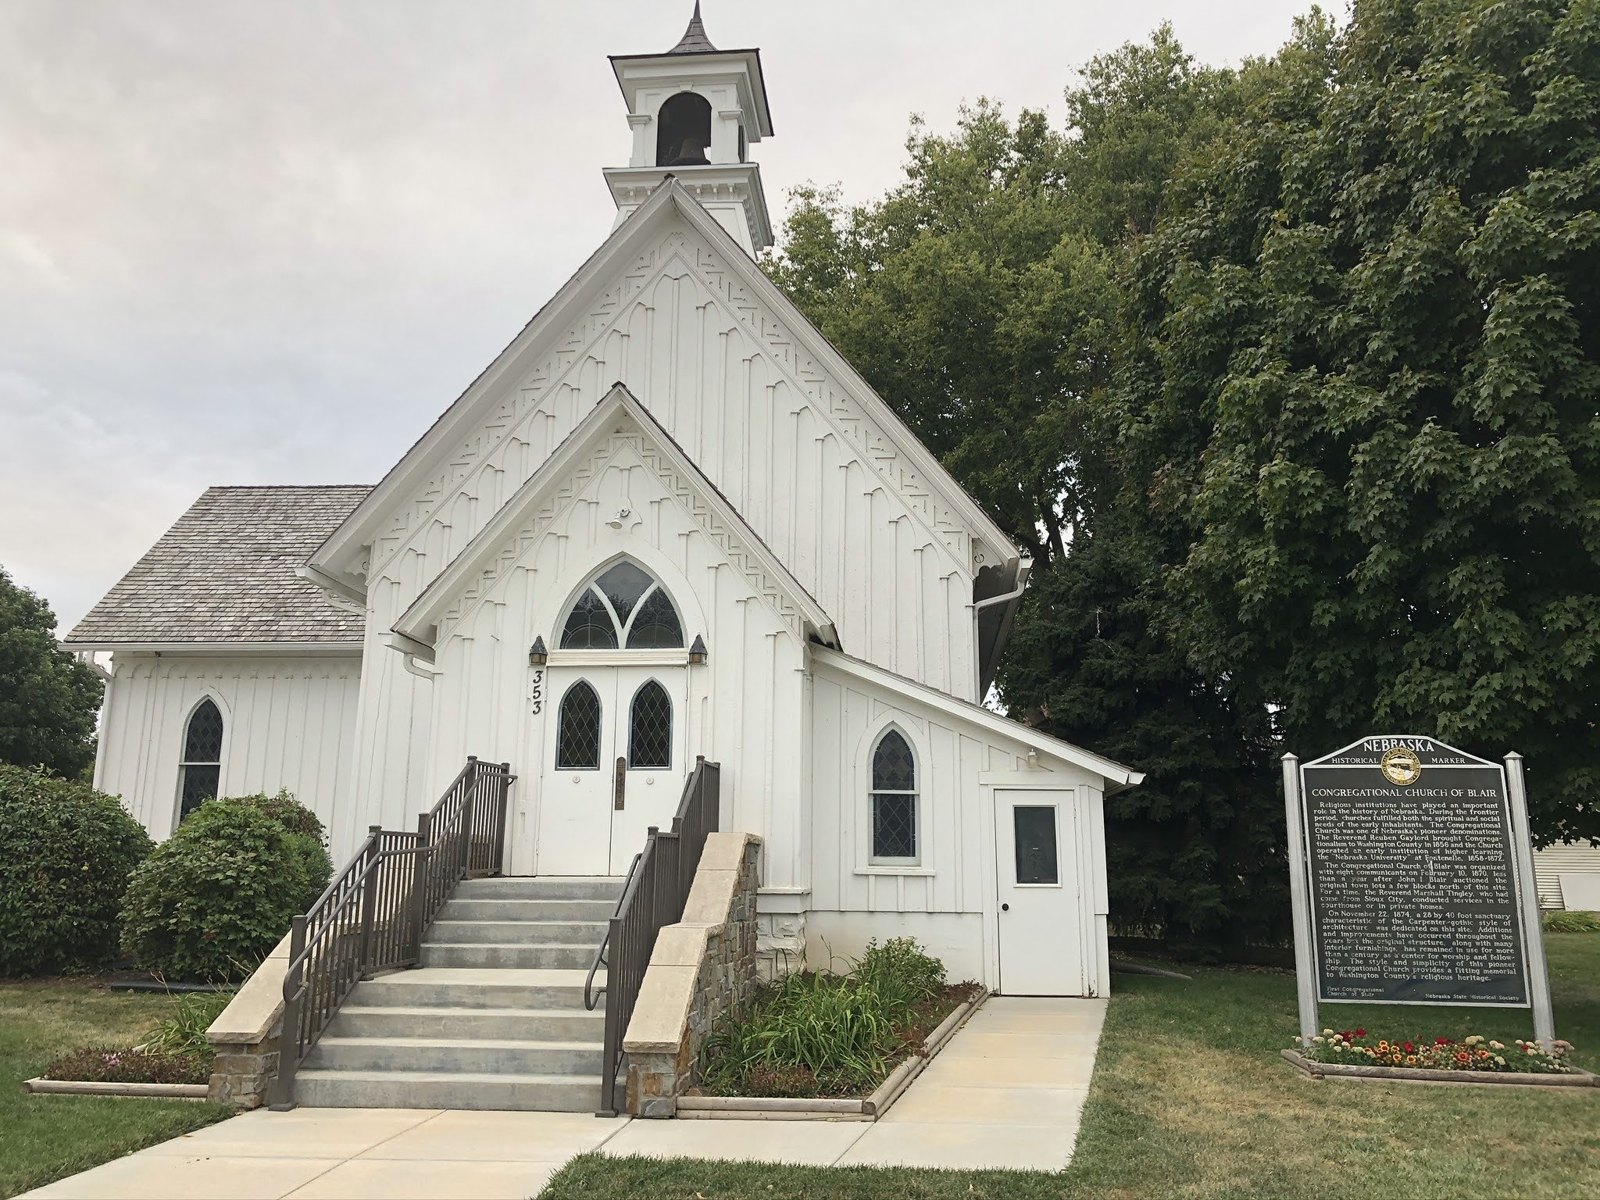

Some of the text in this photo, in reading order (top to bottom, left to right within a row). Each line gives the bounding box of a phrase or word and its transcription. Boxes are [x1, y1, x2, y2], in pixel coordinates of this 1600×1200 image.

[532, 670, 544, 715] 353
[1364, 739, 1434, 752] NEBRASKA
[1312, 788, 1497, 797] CONGREGATIONAL CHURCH OF BLAIR
[1455, 933, 1496, 941] throughout
[1442, 953, 1470, 961] worship
[1325, 964, 1380, 973] Congregational
[1412, 966, 1444, 974] provides
[1454, 967, 1480, 975] fitting
